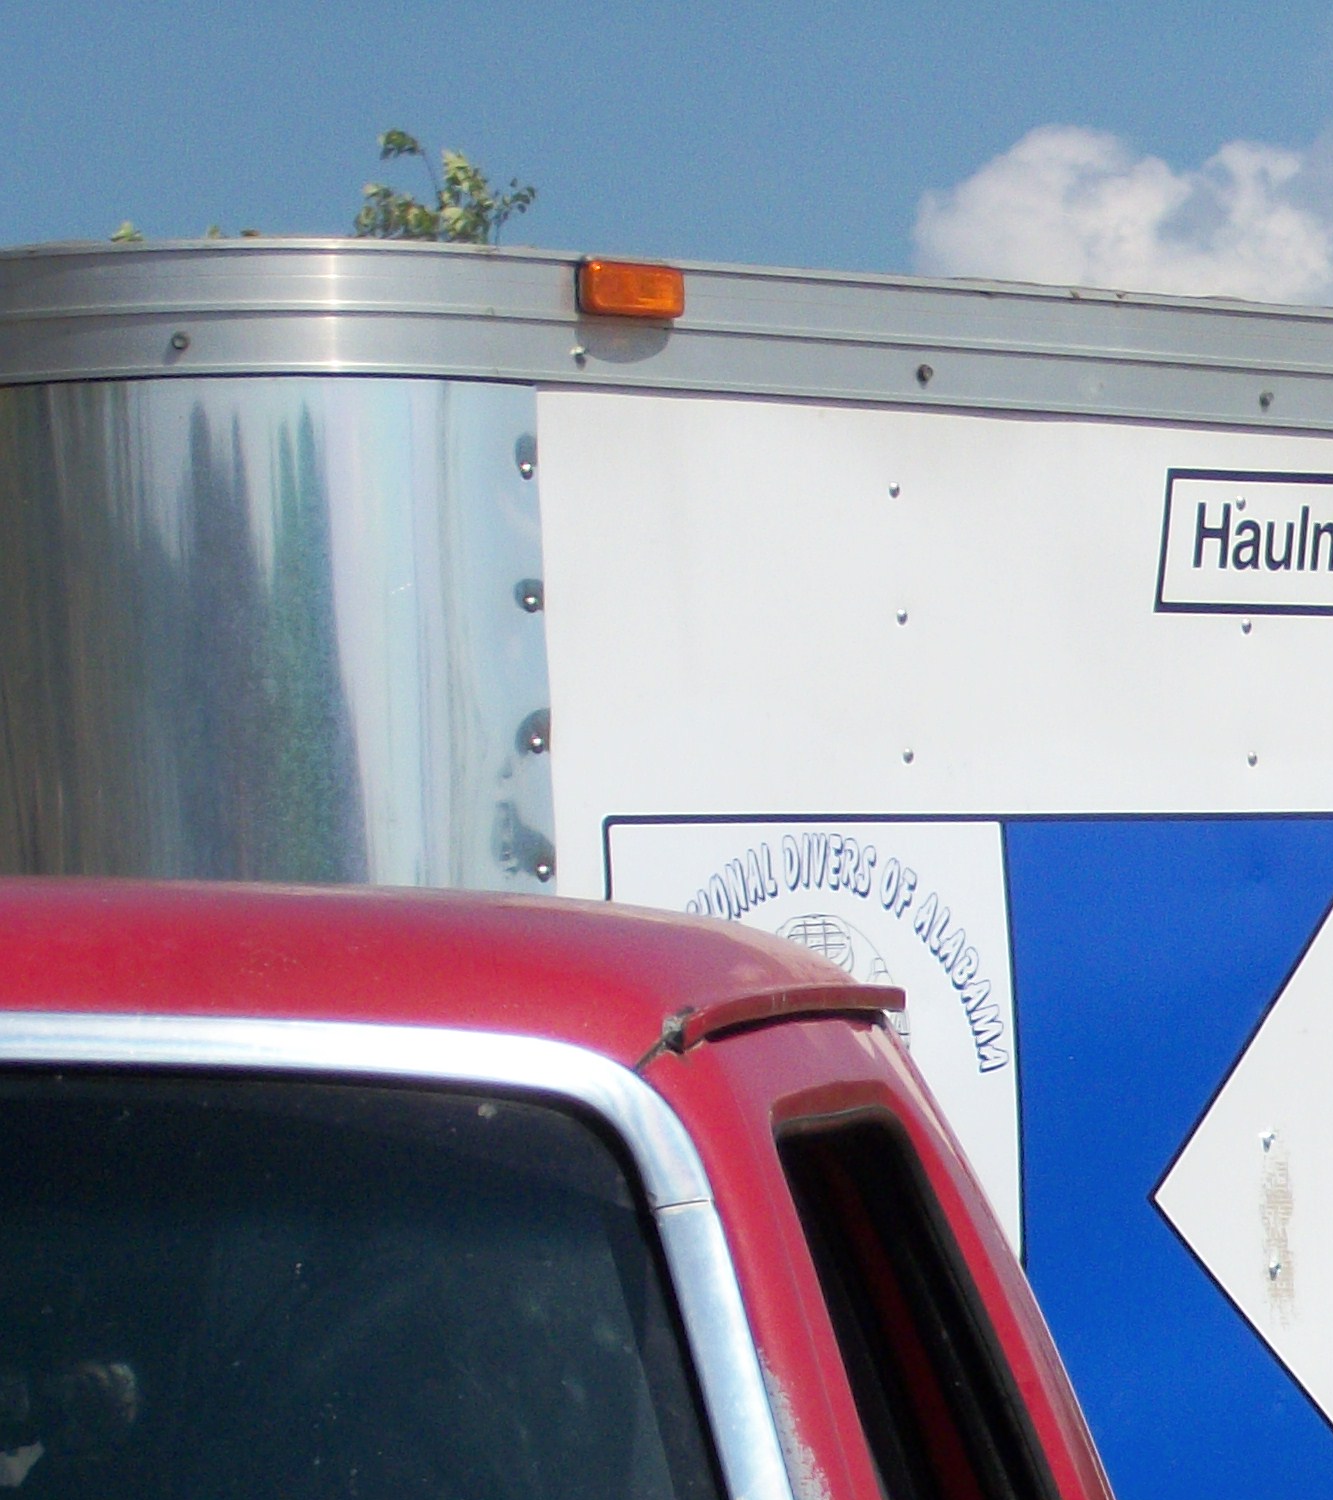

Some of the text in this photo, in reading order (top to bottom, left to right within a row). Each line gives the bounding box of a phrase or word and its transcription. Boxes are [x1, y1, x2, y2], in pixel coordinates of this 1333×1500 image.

[686, 832, 1009, 1074] IONAL DIVERS OF ALABAMA
